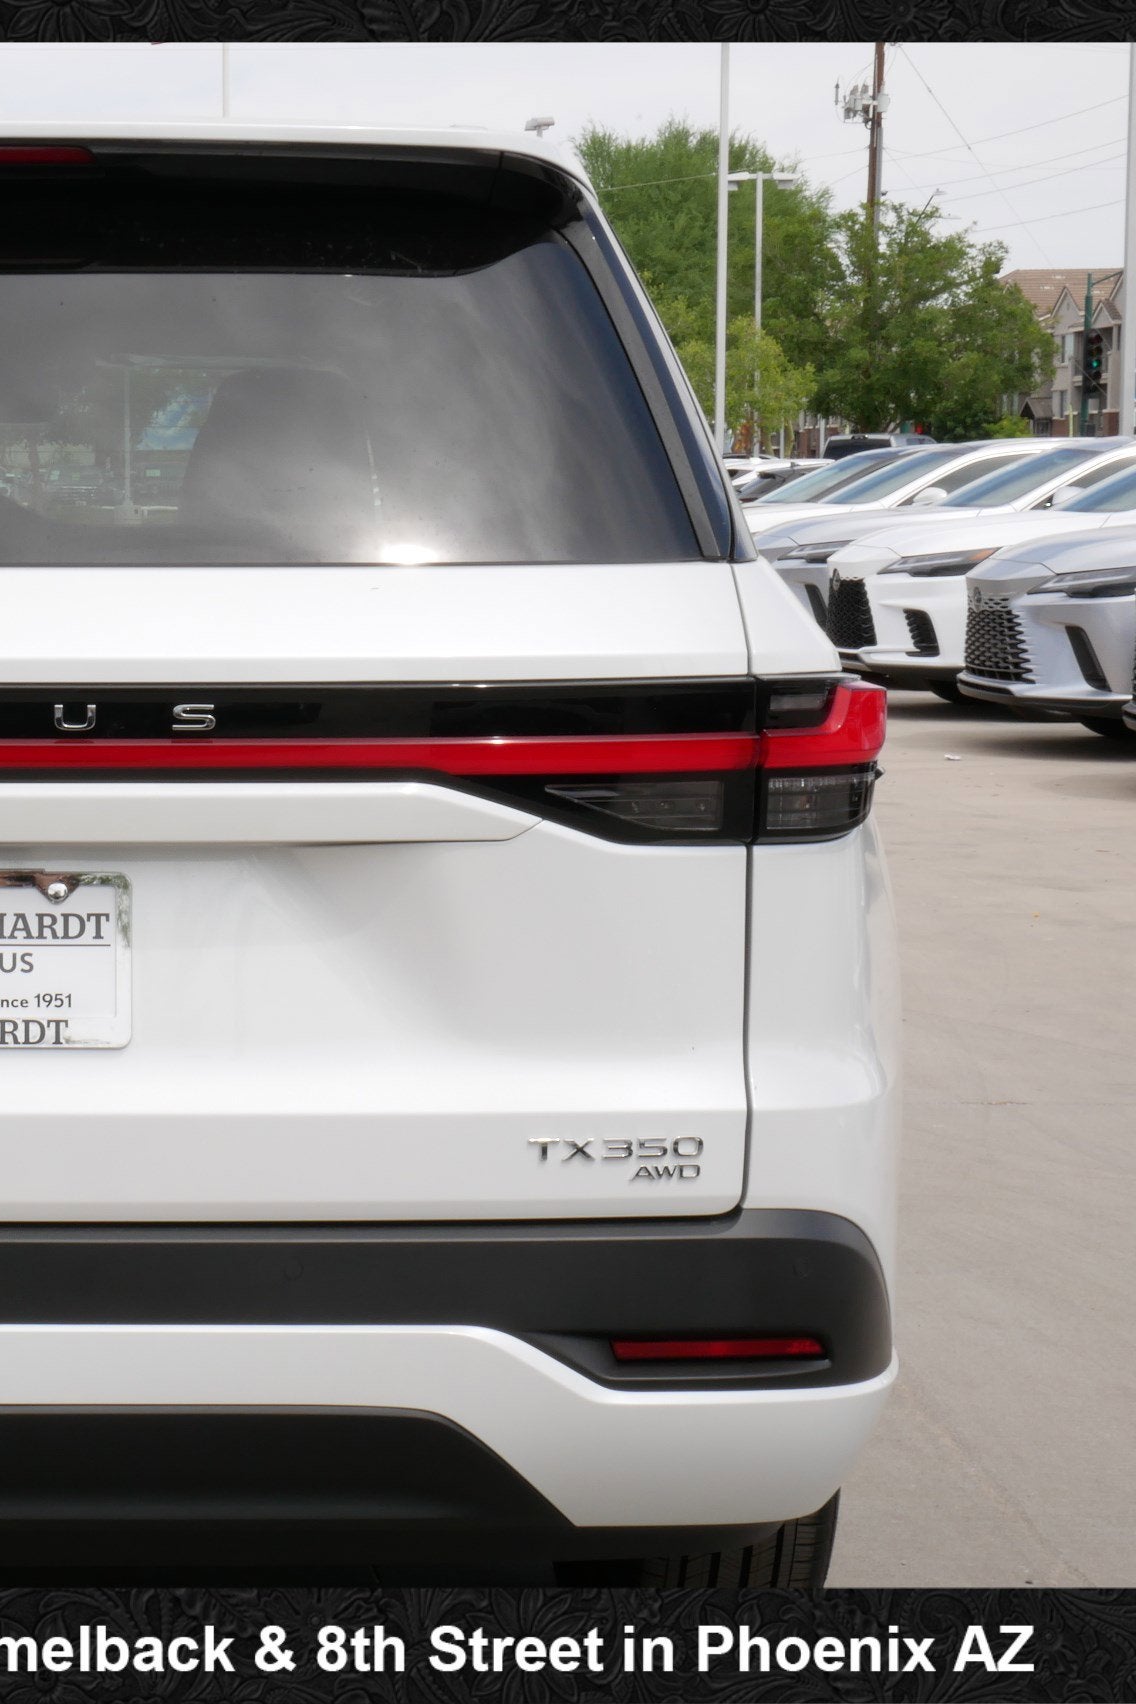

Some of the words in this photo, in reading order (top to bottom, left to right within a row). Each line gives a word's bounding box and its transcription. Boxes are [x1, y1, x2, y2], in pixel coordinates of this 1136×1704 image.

[33, 993, 73, 1009] 1951
[527, 1136, 704, 1161] TX350
[630, 1164, 701, 1181] AWD
